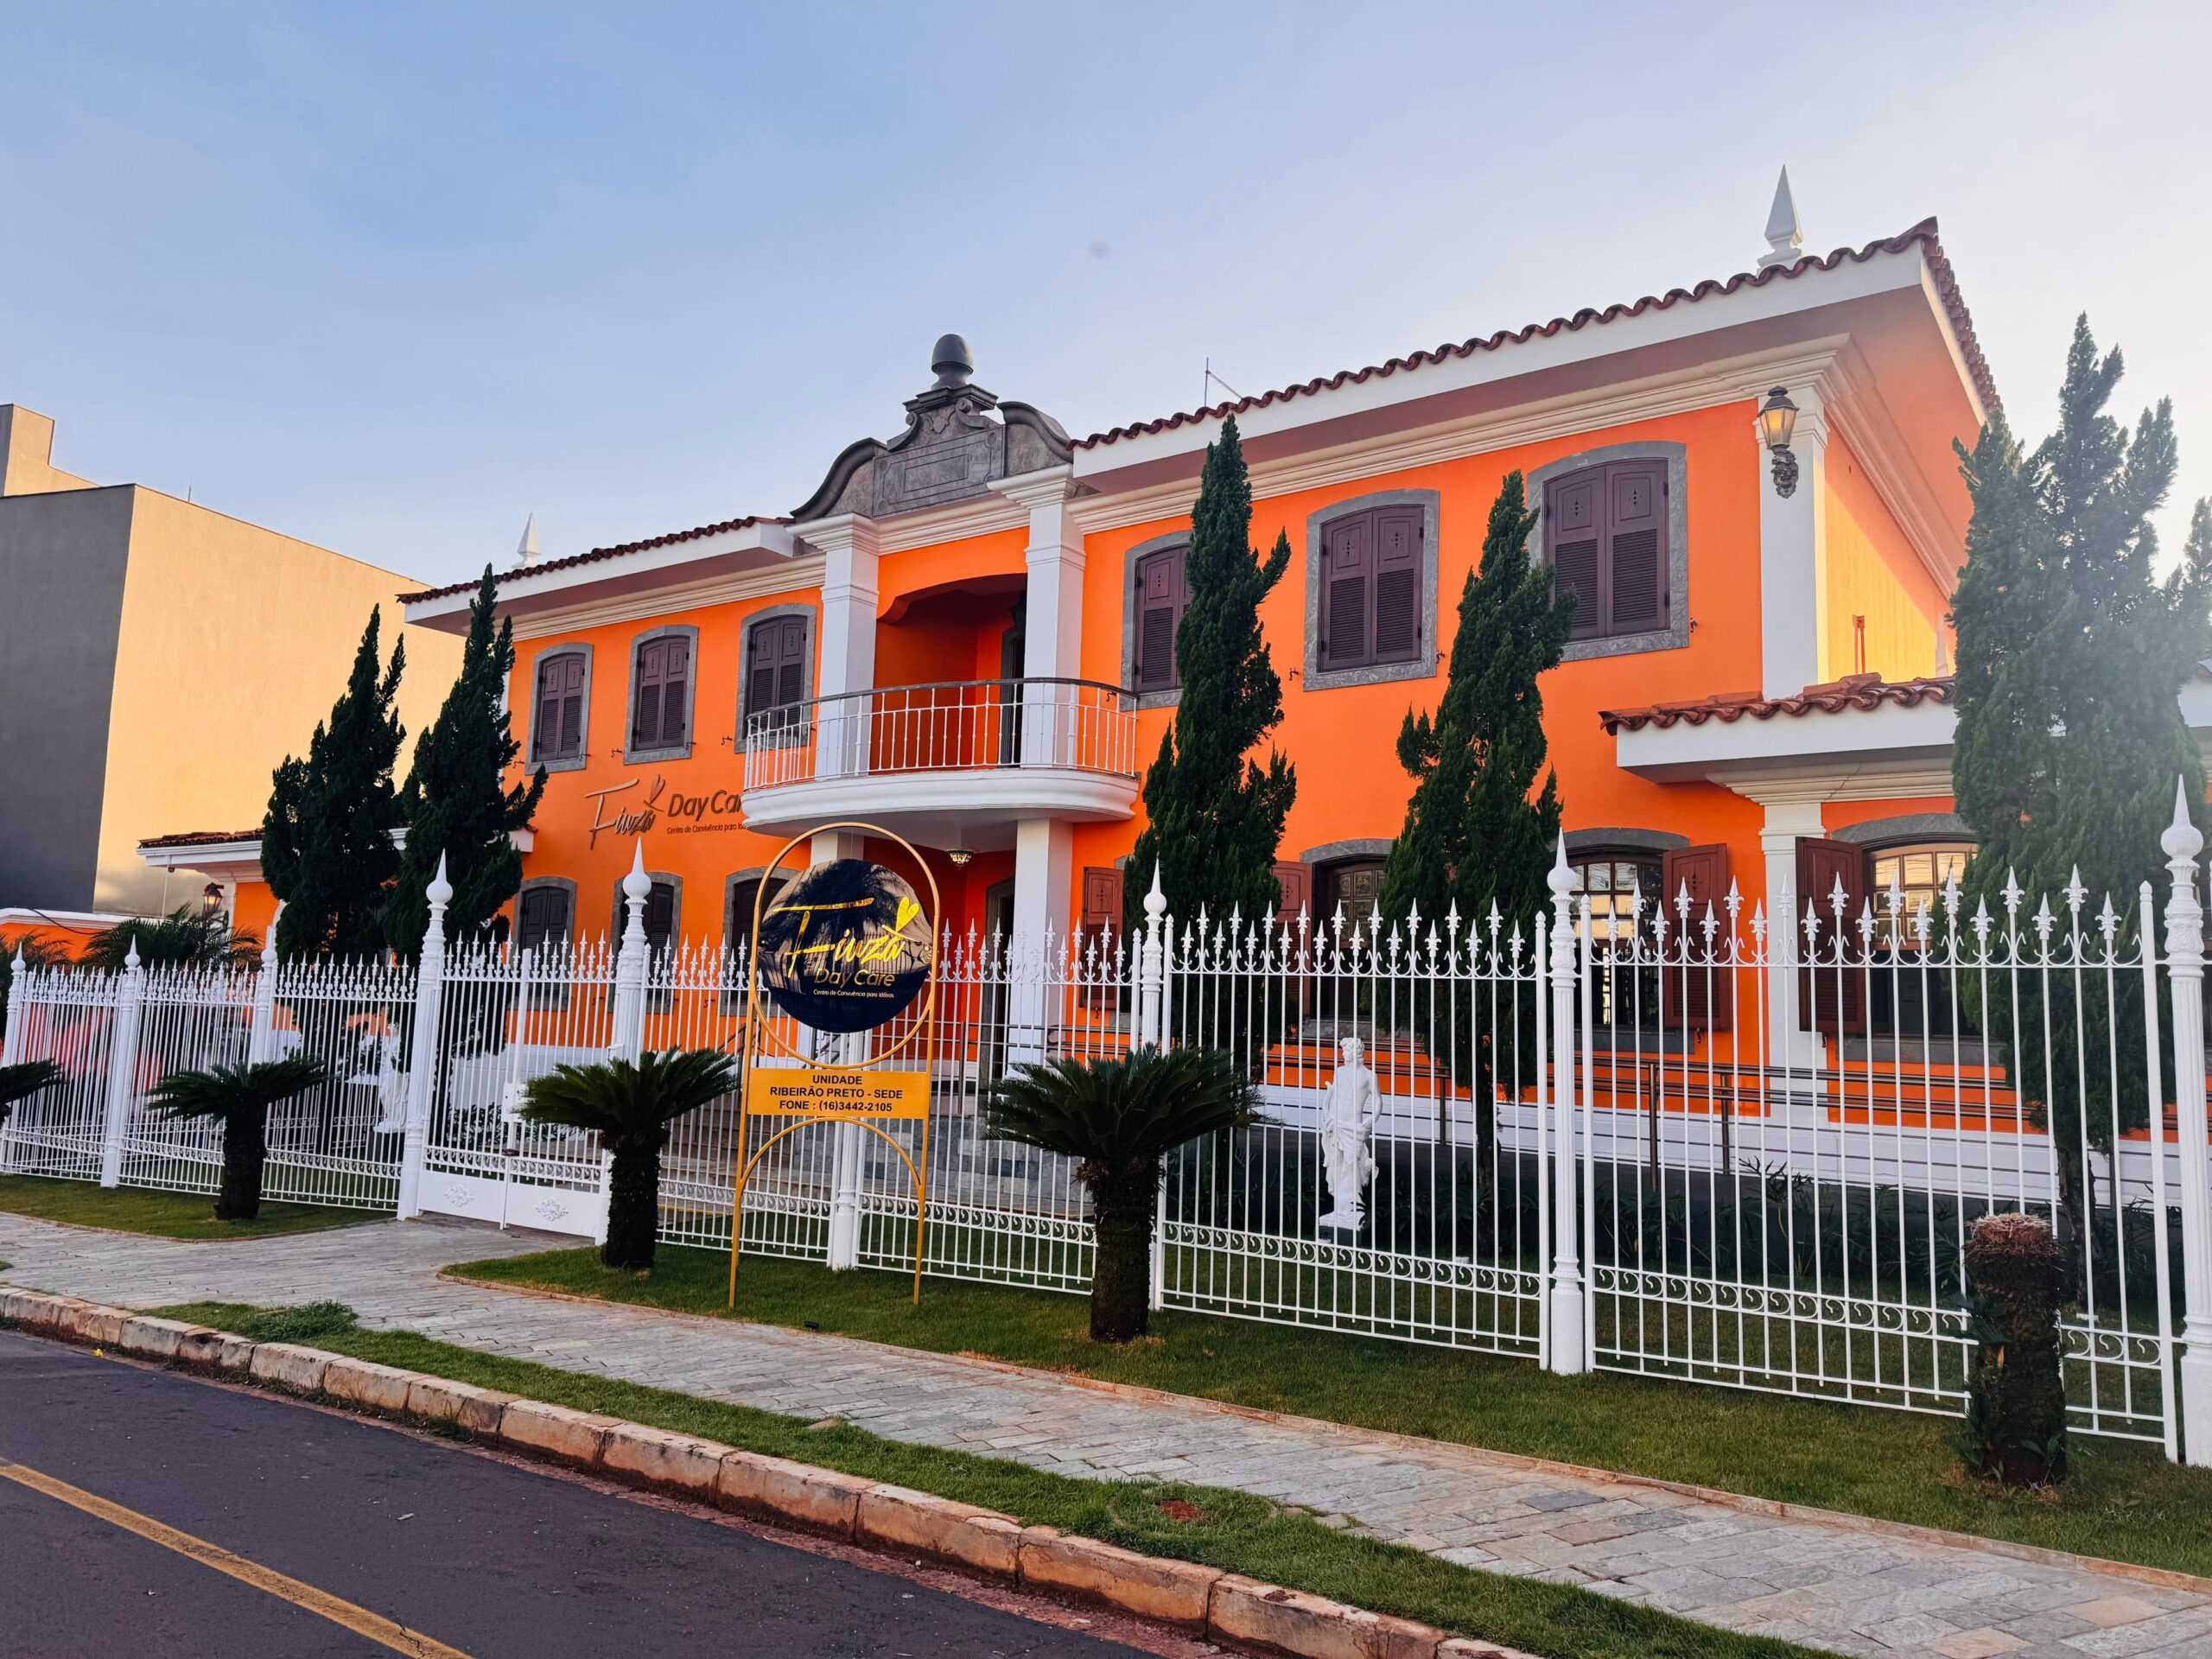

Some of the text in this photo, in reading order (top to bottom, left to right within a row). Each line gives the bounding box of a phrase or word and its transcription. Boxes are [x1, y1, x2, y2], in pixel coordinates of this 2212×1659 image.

[668, 789, 741, 822] Day Car
[667, 826, 683, 835] Centro
[724, 823, 736, 832] para
[814, 967, 895, 988] Day Care
[812, 1074, 862, 1085] UNIDADE
[770, 1085, 824, 1097] RIBEIRÃO
[826, 1088, 865, 1098] PRETO
[874, 1089, 903, 1099] SEDE
[779, 1100, 810, 1110] FONE
[818, 1100, 893, 1112] (16)3442-2105
